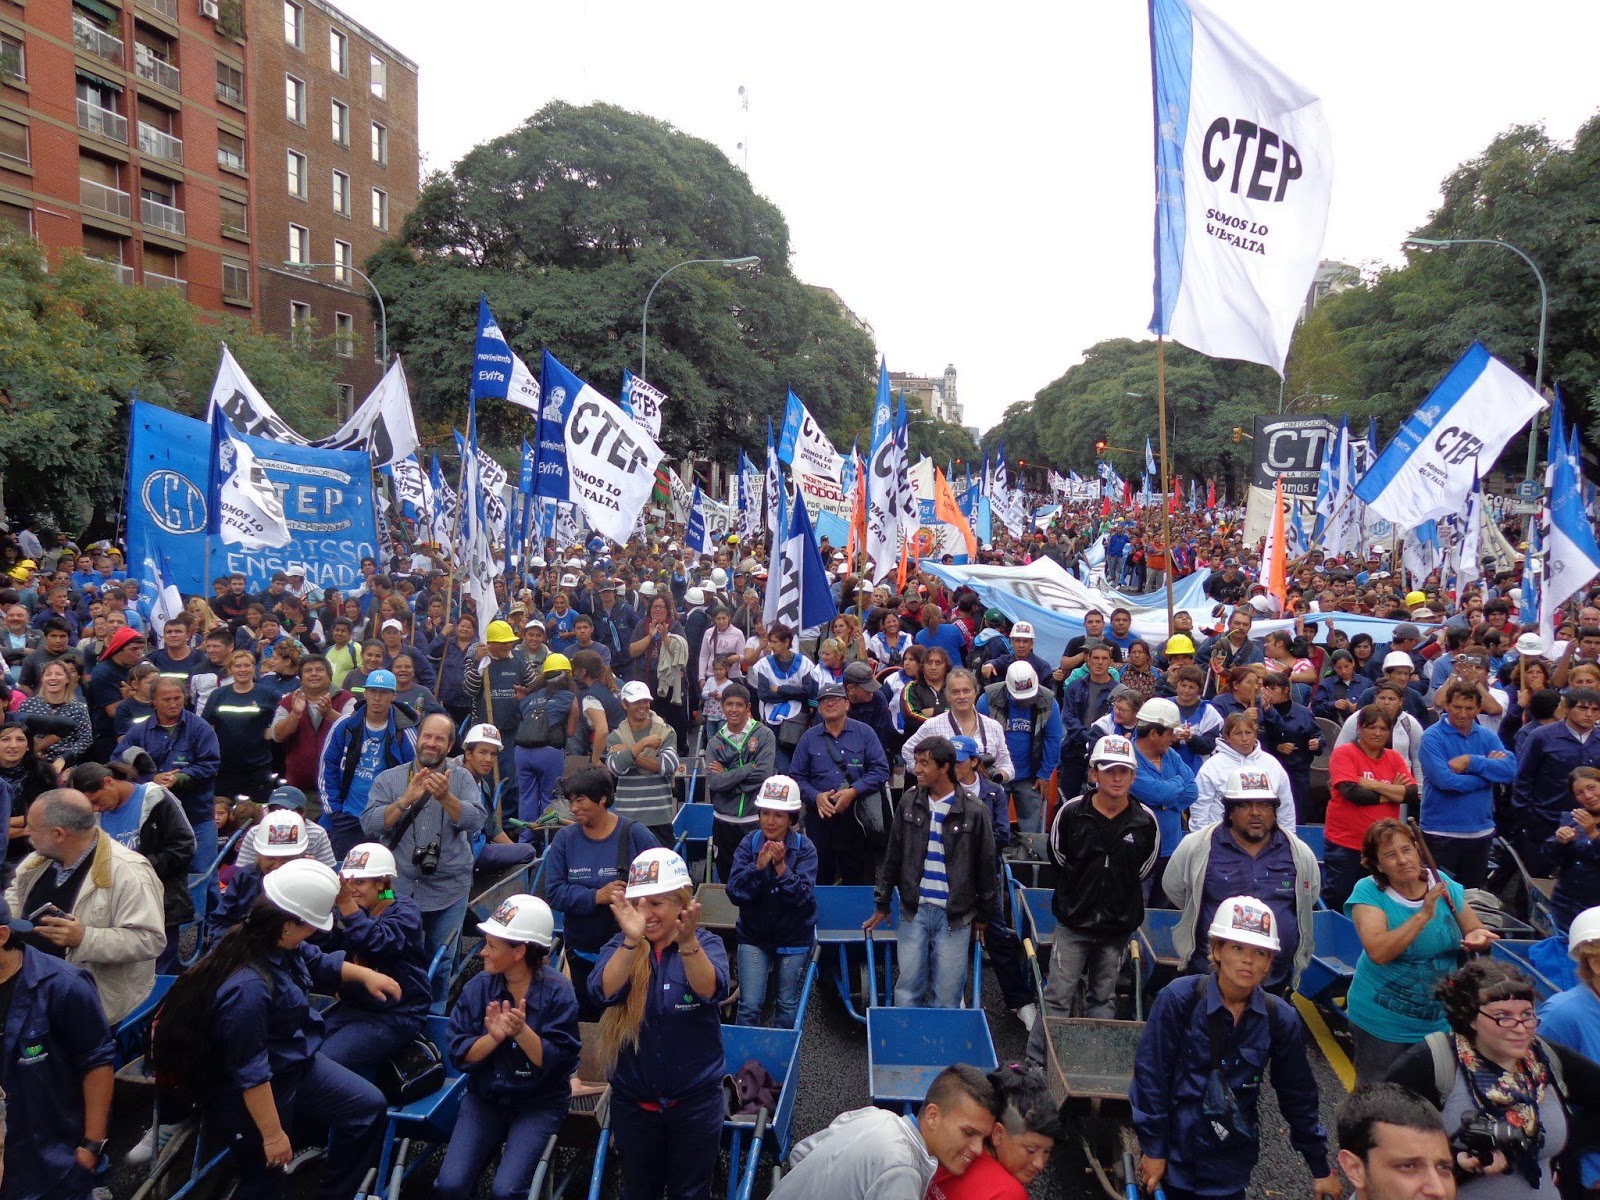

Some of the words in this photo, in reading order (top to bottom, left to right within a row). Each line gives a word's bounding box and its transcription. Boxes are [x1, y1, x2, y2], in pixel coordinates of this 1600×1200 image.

[1202, 117, 1302, 202] CTEP
[1206, 208, 1248, 230] SOMOS
[1250, 222, 1268, 236] LO
[479, 370, 504, 382] Evita
[571, 401, 648, 474] CTEP
[1435, 426, 1484, 465] CTEP
[538, 461, 563, 477] Evita
[272, 483, 343, 515] TEP
[584, 488, 620, 512] FALTA
[606, 481, 622, 497] LO
[250, 515, 264, 532] LO
